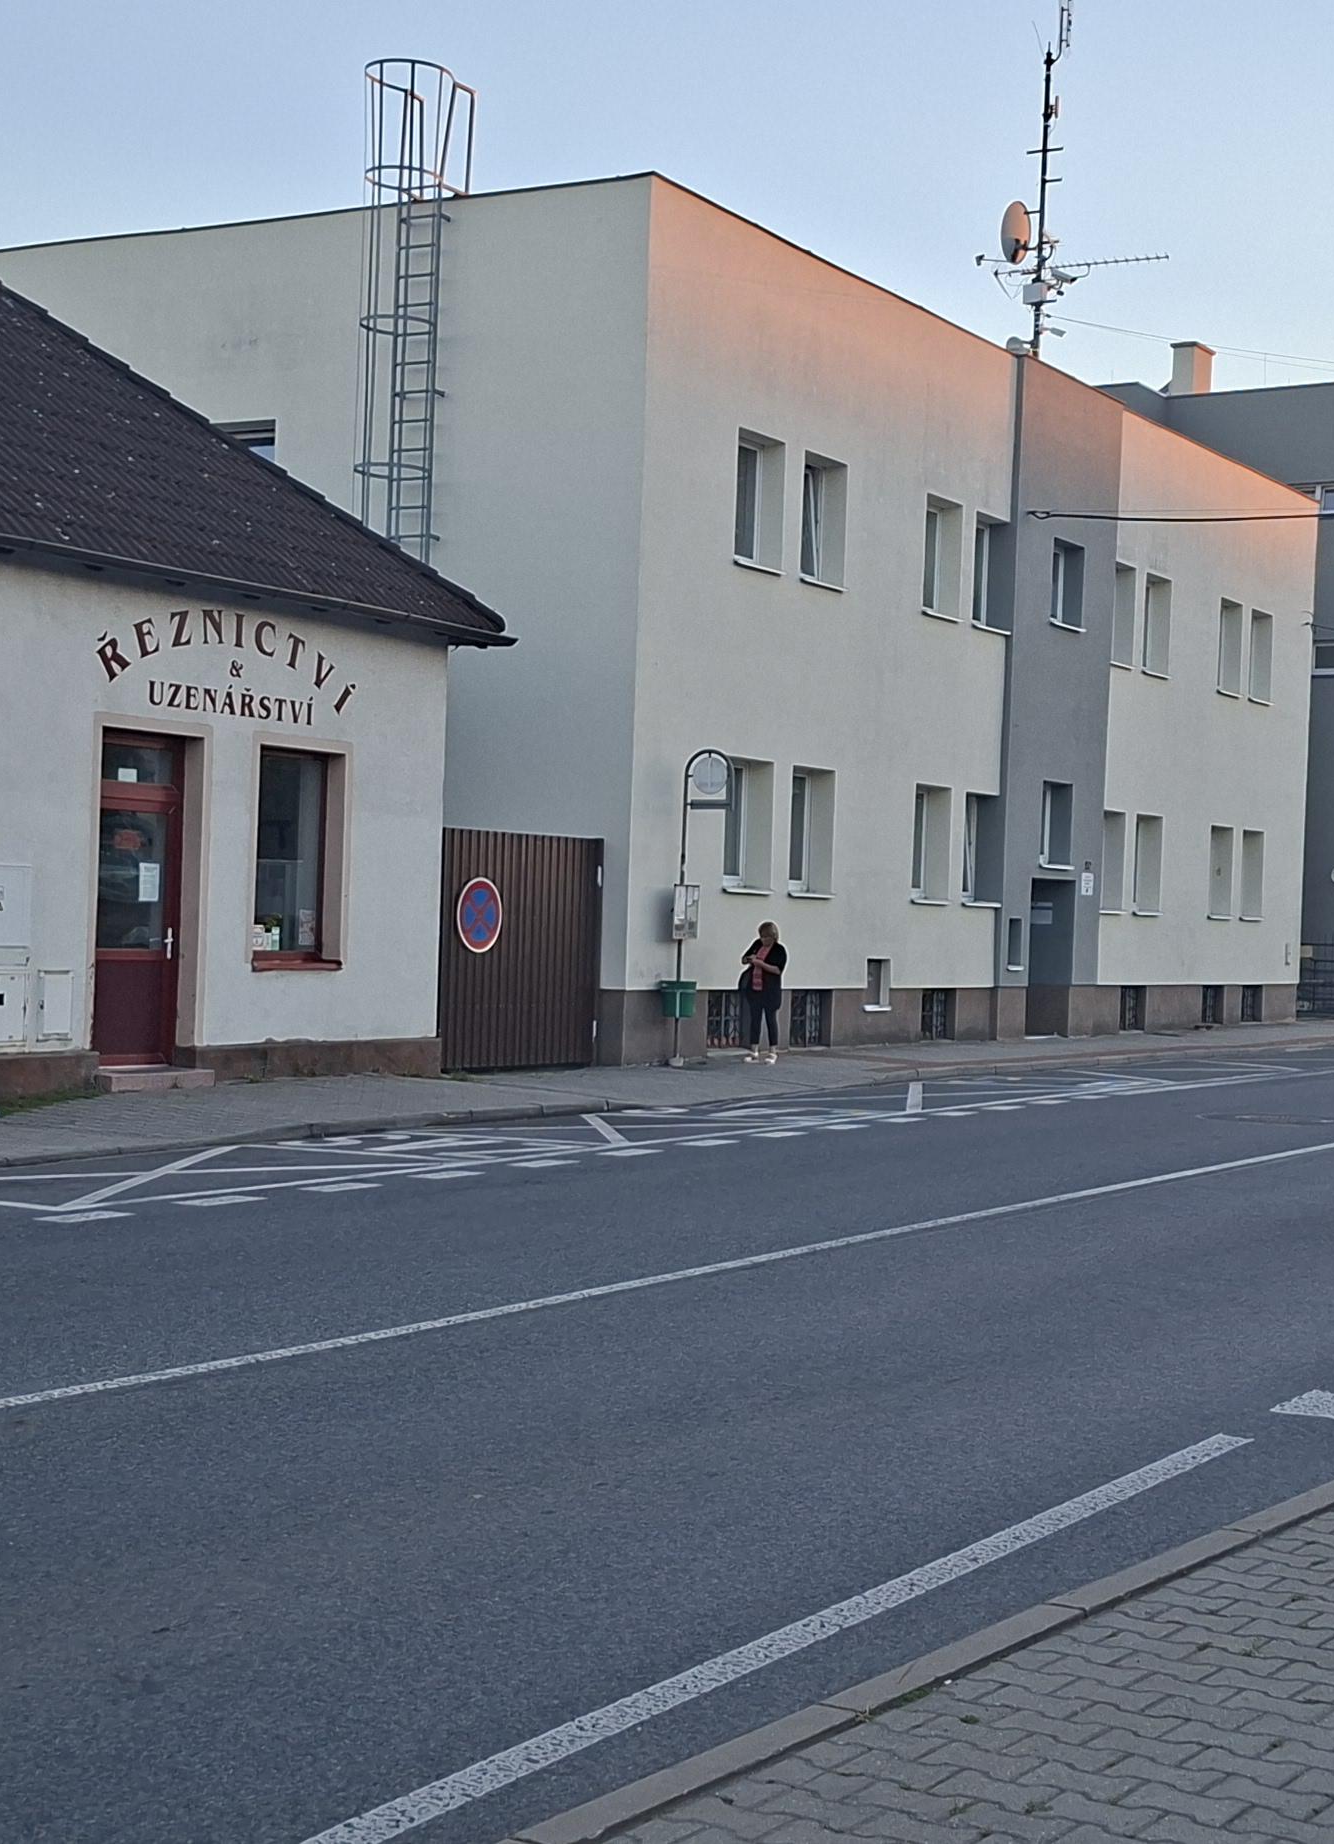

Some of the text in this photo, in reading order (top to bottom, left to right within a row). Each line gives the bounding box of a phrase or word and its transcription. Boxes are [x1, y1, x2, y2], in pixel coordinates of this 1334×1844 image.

[96, 609, 357, 715] ŘEZNICTVÍ
[229, 659, 244, 679] &
[148, 680, 314, 726] UZENÁŘSTVÍ
